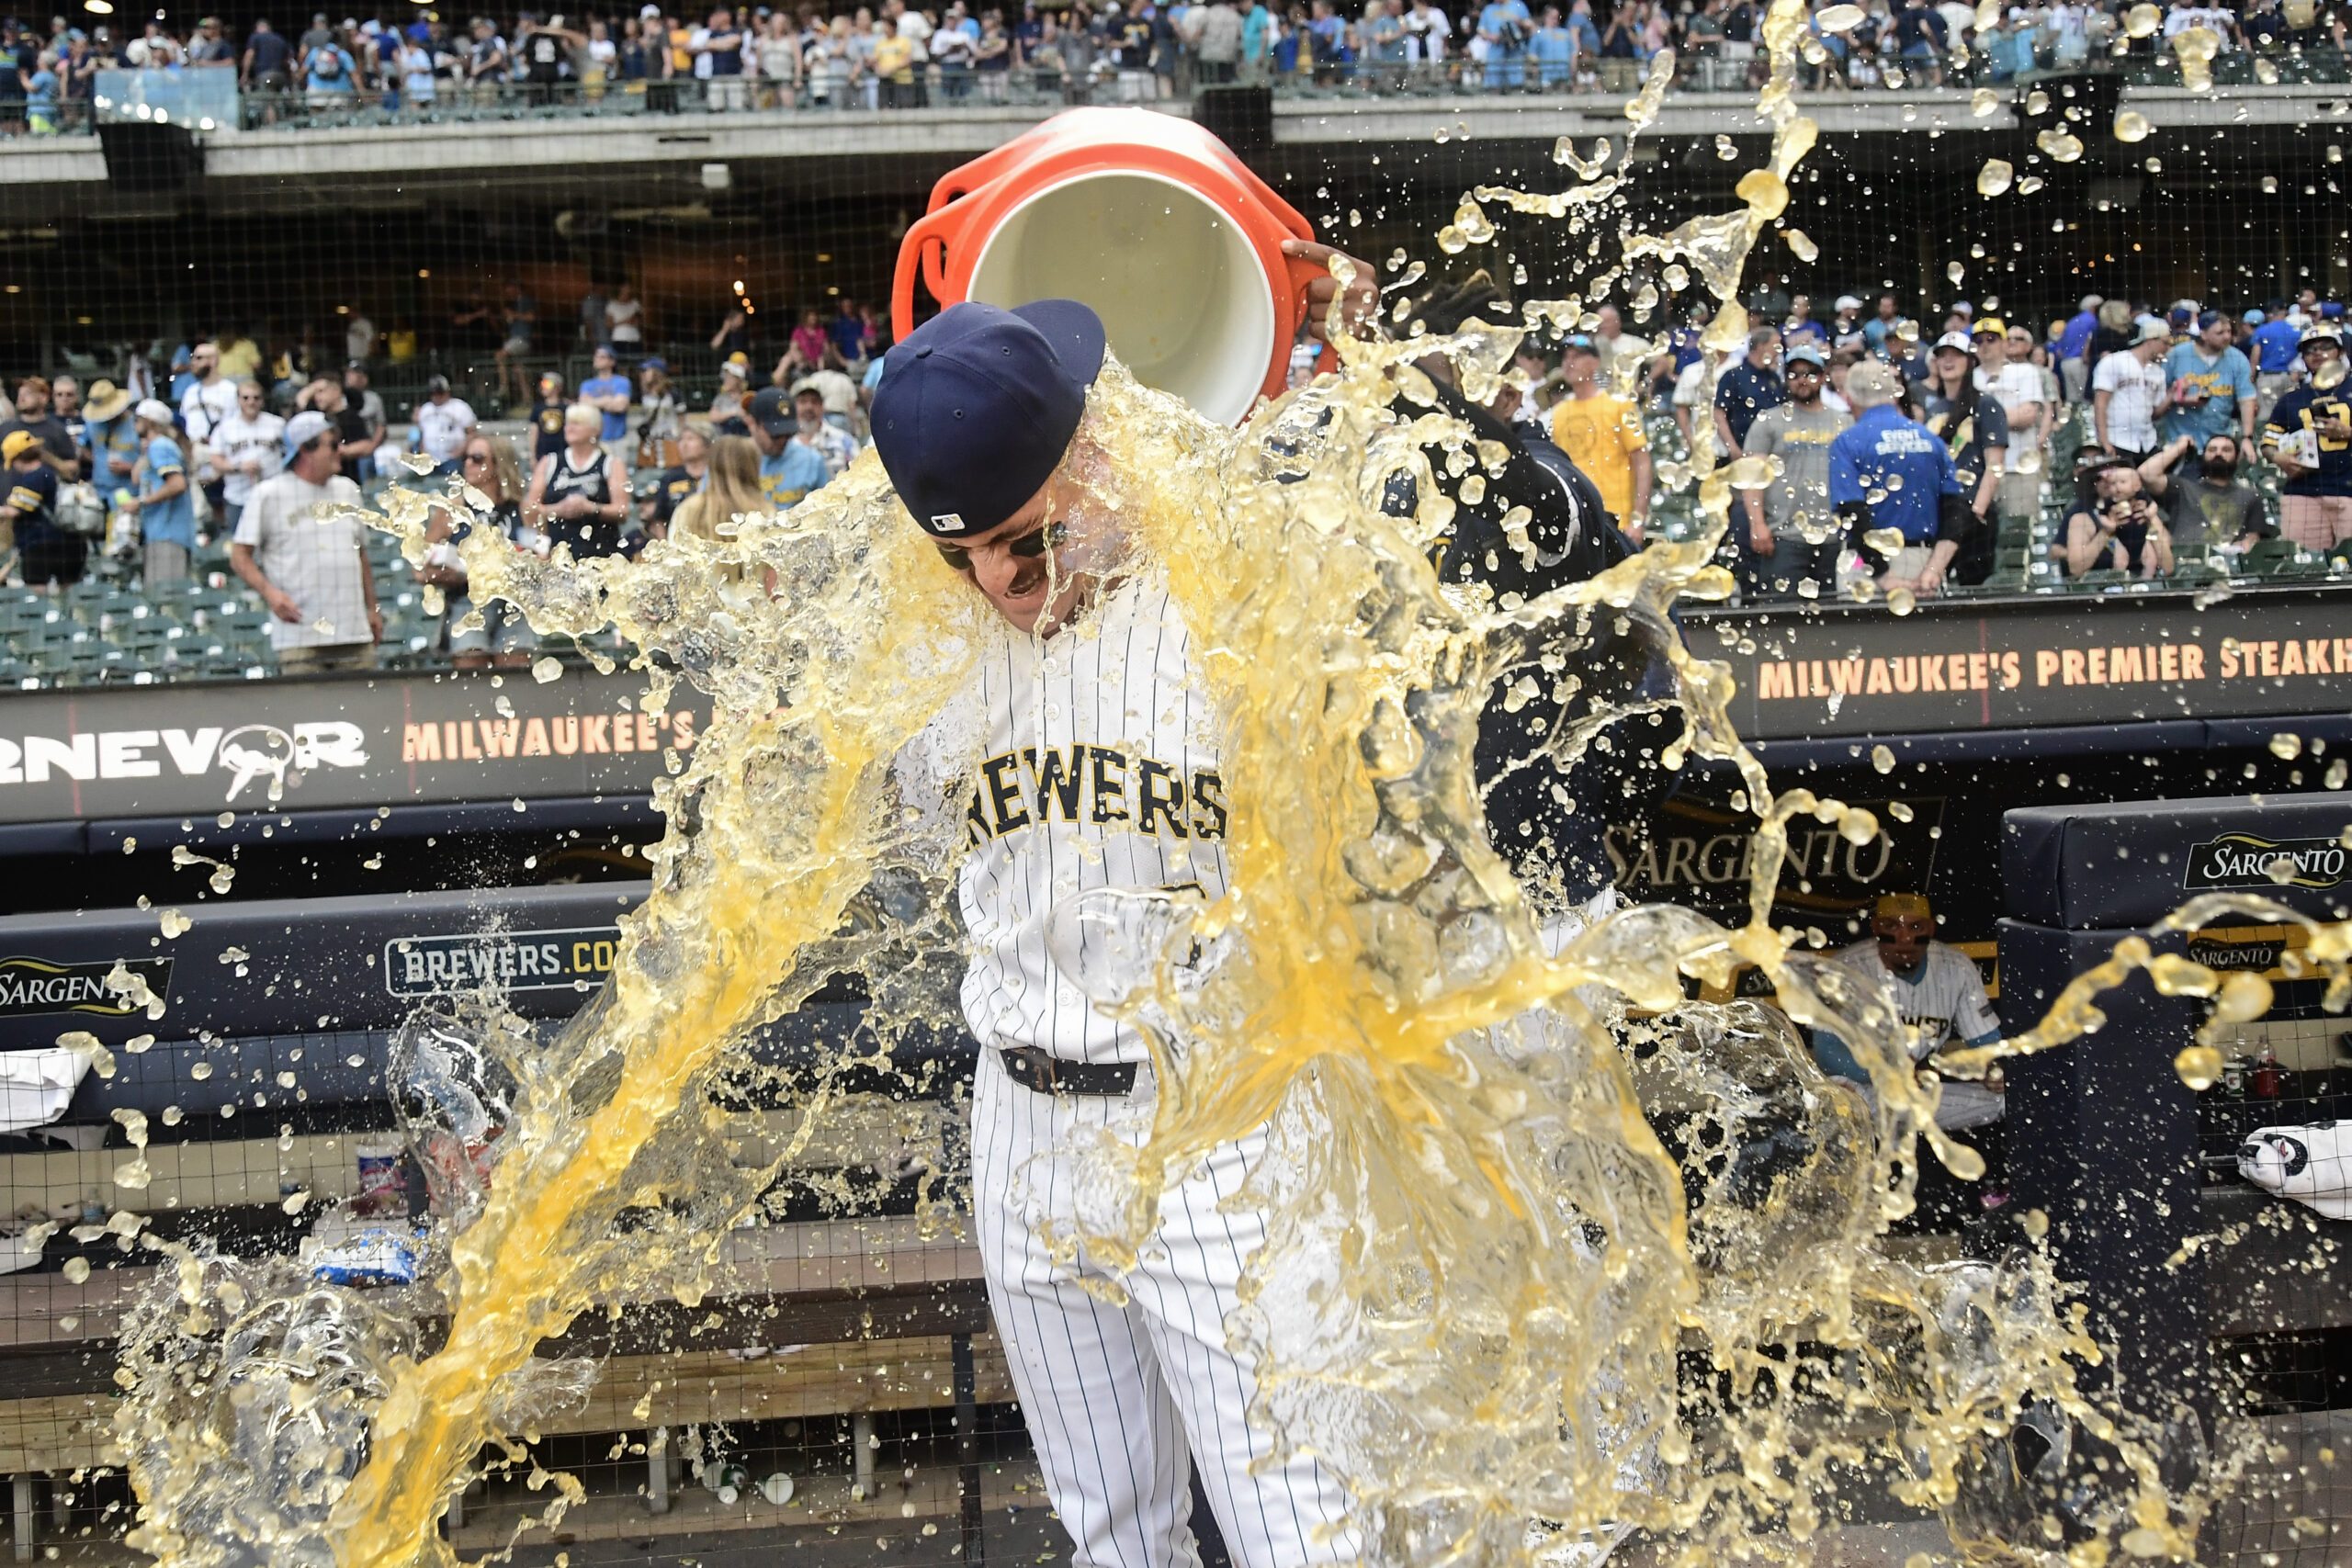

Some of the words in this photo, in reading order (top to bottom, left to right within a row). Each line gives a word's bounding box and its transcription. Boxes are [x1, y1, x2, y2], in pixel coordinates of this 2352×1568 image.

[1881, 429, 1920, 442] EVENT
[1758, 651, 2021, 699] MILWAUKEE'S
[2036, 644, 2205, 686] PREMIER
[2220, 637, 2352, 679] STEAKH
[402, 710, 696, 761] MILWAUKEE'S
[404, 941, 627, 984] BREWERS.CO
[2190, 947, 2272, 964] SARGENTO
[0, 972, 147, 1007] SARGEN
